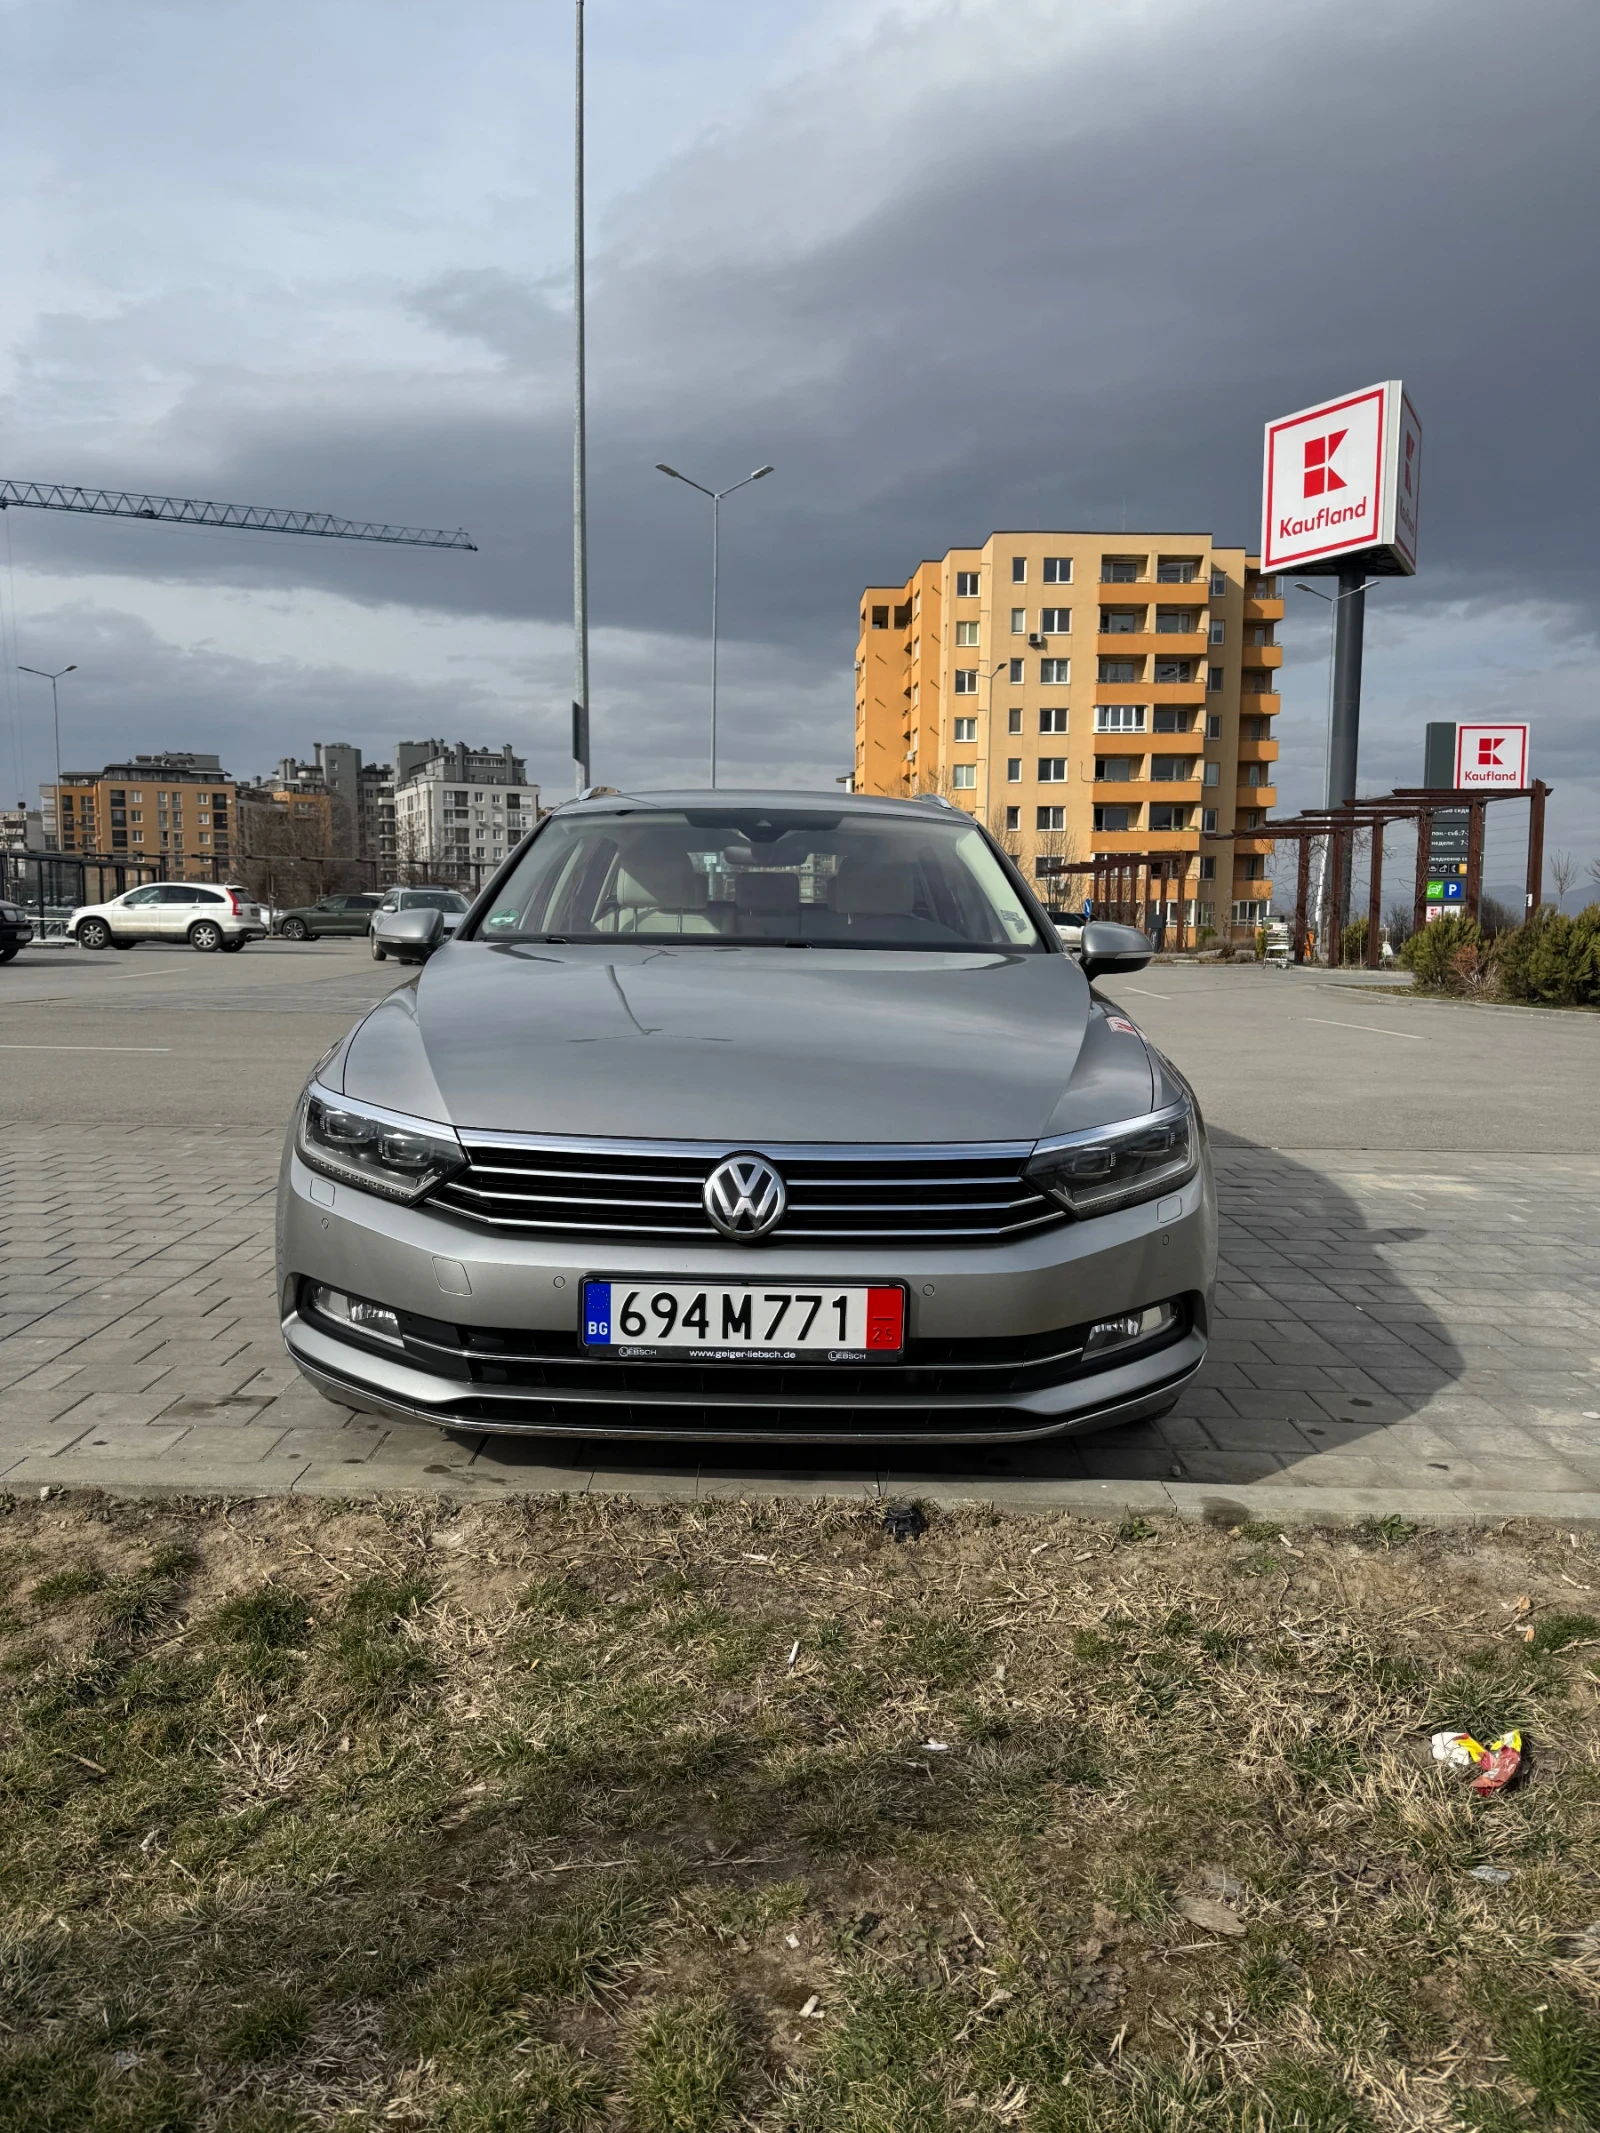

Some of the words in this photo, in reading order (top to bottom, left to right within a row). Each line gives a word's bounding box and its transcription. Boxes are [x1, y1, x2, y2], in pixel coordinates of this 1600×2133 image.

[1280, 496, 1367, 539] Kaufland
[1464, 770, 1517, 781] Kaufland
[1448, 884, 1457, 896] P
[587, 1321, 608, 1335] BG
[872, 1327, 895, 1342] 25
[689, 1349, 796, 1360] www.geiger-liebsch.de
